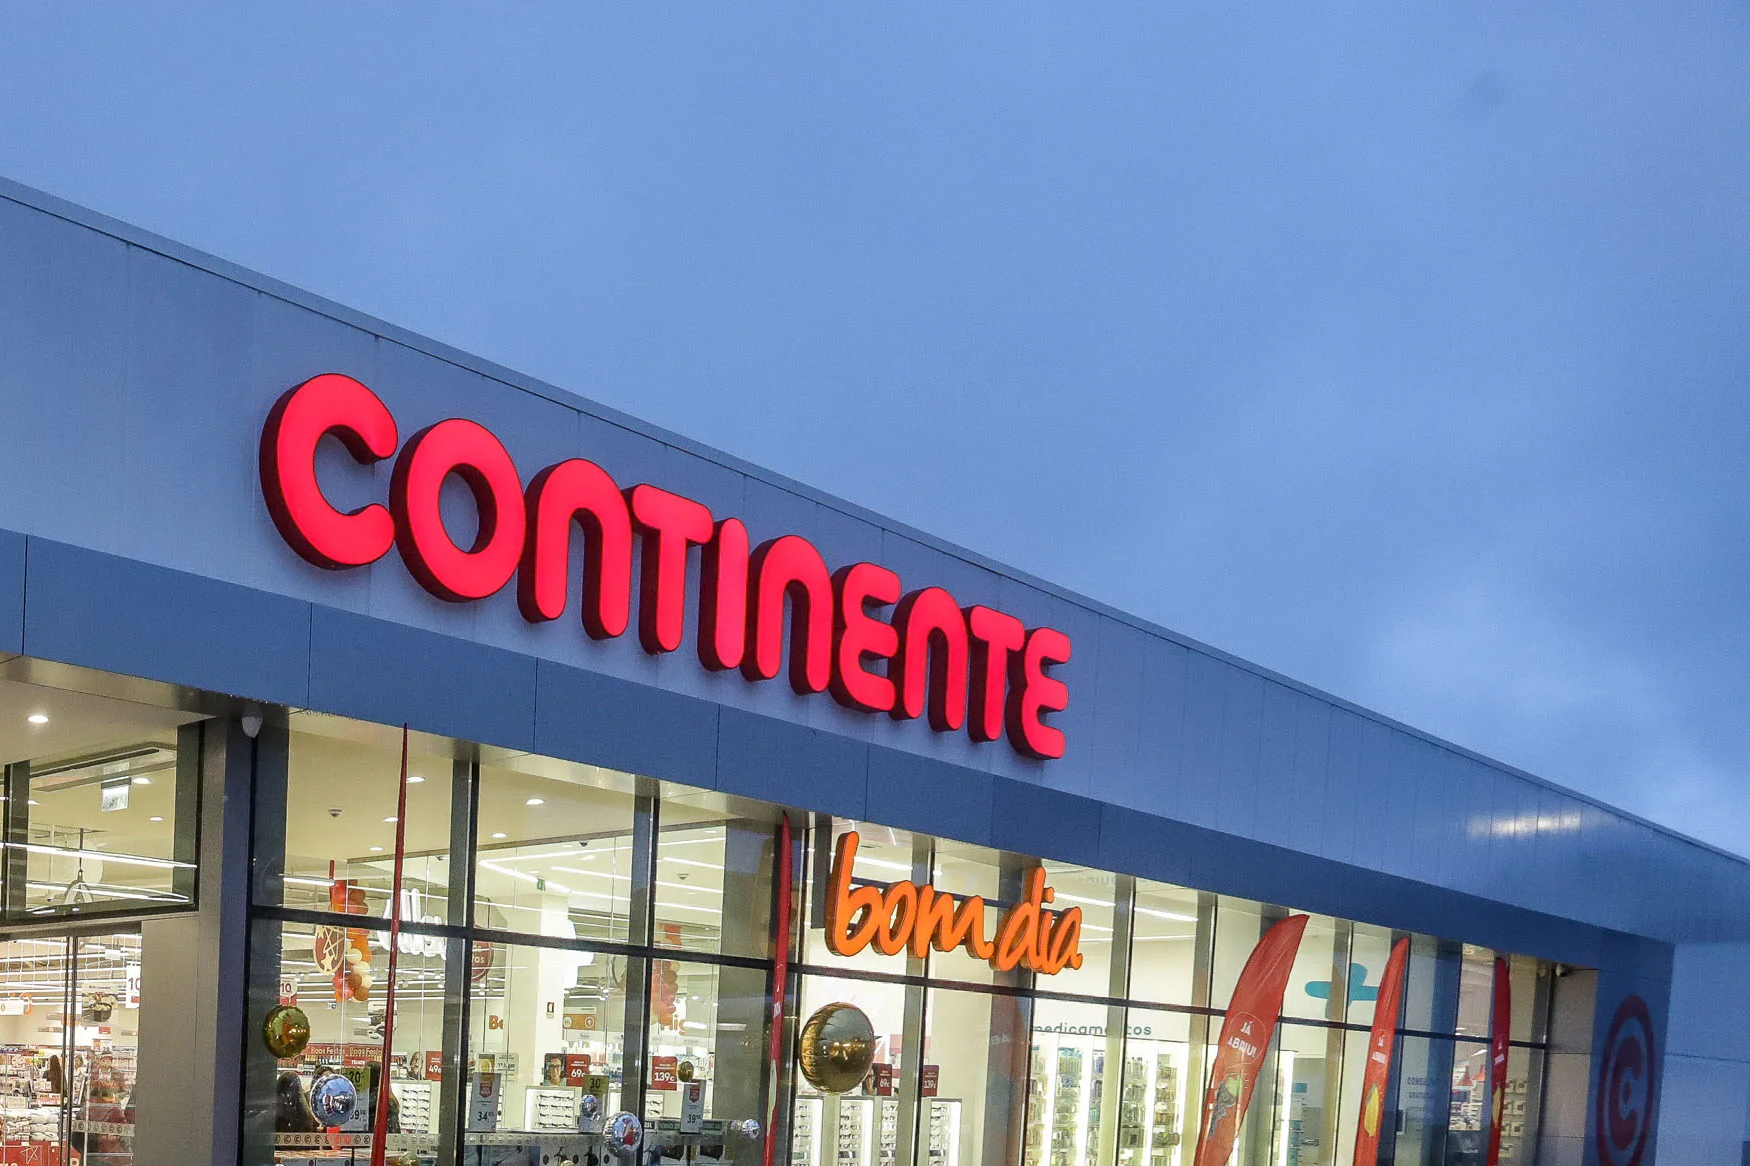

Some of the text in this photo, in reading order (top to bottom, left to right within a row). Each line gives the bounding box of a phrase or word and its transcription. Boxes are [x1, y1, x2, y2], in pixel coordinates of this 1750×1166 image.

[259, 373, 1070, 760] CONTINENTE
[825, 831, 1083, 975] bom dia
